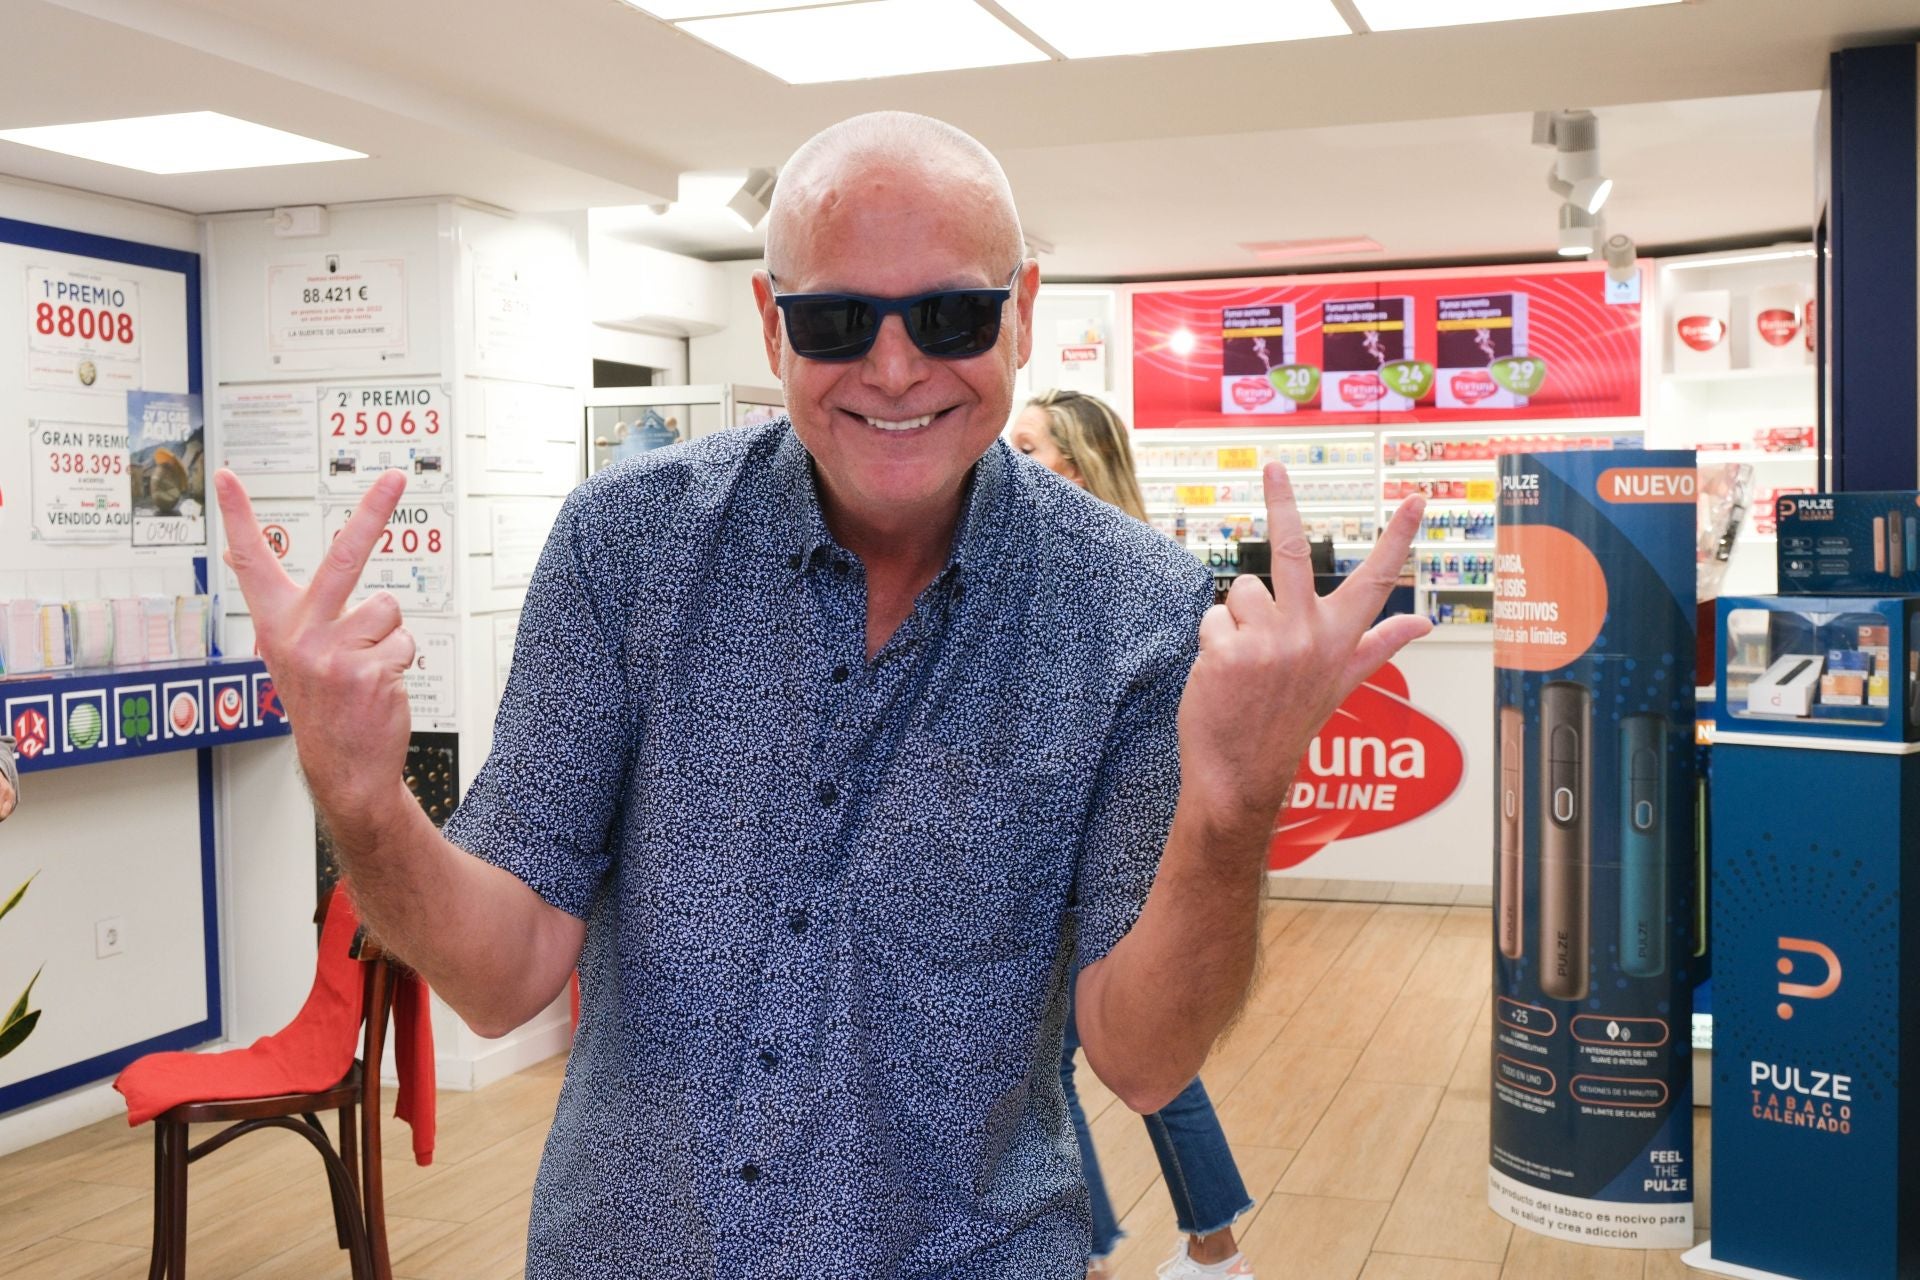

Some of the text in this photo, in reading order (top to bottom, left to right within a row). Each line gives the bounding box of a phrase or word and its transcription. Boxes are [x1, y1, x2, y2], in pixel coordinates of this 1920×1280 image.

[57, 281, 125, 308] PREMIO
[303, 285, 368, 303] 88.421 €
[36, 302, 134, 344] 88008
[1285, 368, 1310, 387] 20
[1398, 365, 1424, 384] 24
[1508, 361, 1534, 381] 29
[362, 389, 431, 406] PREMIO
[330, 410, 440, 437] 25063
[42, 431, 83, 447] GRAN
[50, 453, 122, 475] 338.395
[1502, 474, 1539, 490] PULZE
[1614, 475, 1694, 496] NUEVO
[1798, 499, 1834, 509] PULZE
[48, 512, 130, 525] VENDIDO AQU
[388, 509, 428, 524] MIO
[1209, 543, 1243, 567] blu
[417, 656, 425, 669] €
[1294, 782, 1397, 811] DLINE
[1557, 930, 1569, 977] PULZE
[1511, 1009, 1529, 1025] +25
[1585, 1046, 1632, 1057] INTENSIDADES
[1590, 1055, 1611, 1064] SUAVE
[1619, 1058, 1648, 1066] INTENSO
[1517, 1069, 1525, 1080] EN
[1526, 1072, 1541, 1085] UNO
[1751, 1061, 1851, 1101] PULZE
[1629, 1089, 1659, 1097] MINUTOS
[1752, 1090, 1851, 1119] TABACO
[1615, 1109, 1624, 1117] DE
[1625, 1110, 1657, 1119] CALADAS
[1752, 1105, 1850, 1134] CALENTADO
[1650, 1151, 1683, 1163] FEEL
[1653, 1165, 1678, 1177] THE
[1644, 1179, 1687, 1192] PULZE
[1502, 1187, 1534, 1206] producto
[1536, 1200, 1551, 1211] del
[1554, 1204, 1592, 1220] tabaco
[1596, 1213, 1610, 1222] es
[1615, 1214, 1656, 1225] nocivo
[1660, 1214, 1686, 1225] para
[1511, 1205, 1637, 1239] su salud y crea adicción
